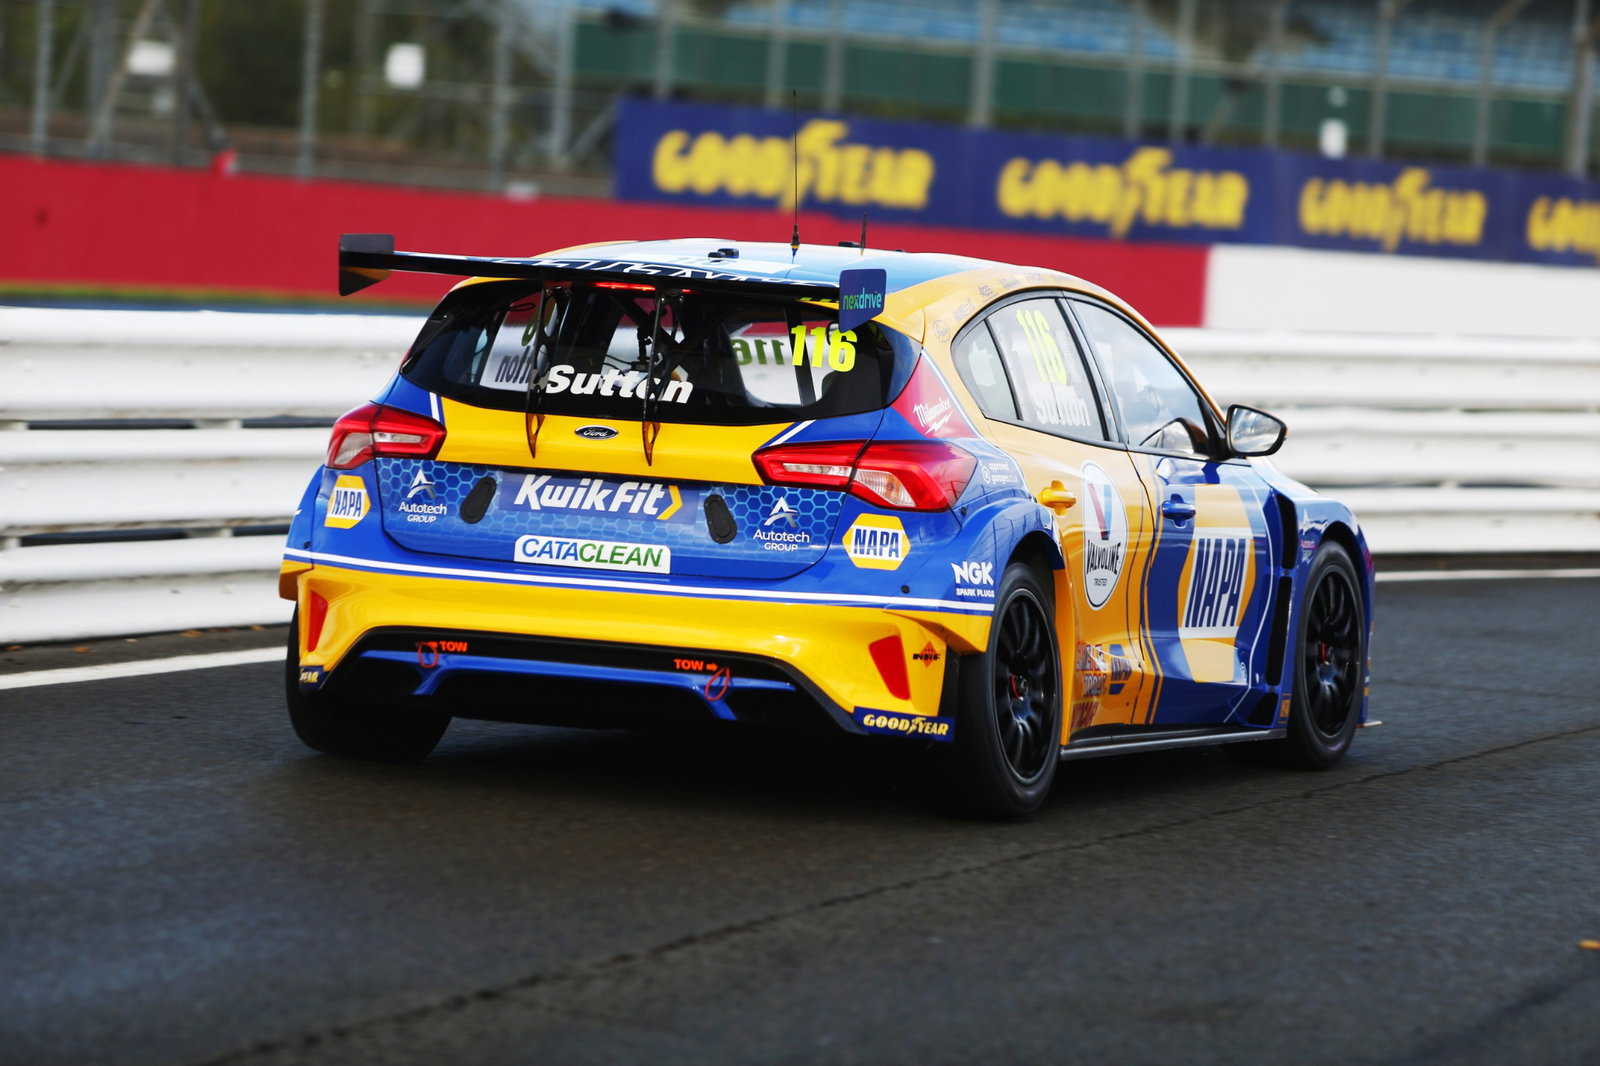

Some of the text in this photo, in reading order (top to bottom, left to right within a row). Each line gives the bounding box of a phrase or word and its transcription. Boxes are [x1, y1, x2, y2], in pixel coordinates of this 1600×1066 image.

[653, 118, 935, 213] GOODYEAR
[998, 146, 1248, 239] GOODYEAR
[1299, 166, 1488, 253] GOODYEAR
[843, 287, 882, 310] nexdrive
[791, 325, 858, 372] 116
[1016, 309, 1067, 385] 116
[546, 364, 693, 404] Sutton
[583, 427, 609, 437] Ford
[331, 488, 362, 518] NAPA
[399, 501, 447, 515] Autotech
[407, 515, 436, 523] GROUP
[753, 529, 809, 543] Autotech
[764, 542, 798, 552] GROUP
[853, 528, 899, 558] NAPA
[521, 538, 663, 568] CATACLEAN
[1086, 539, 1121, 575] VALVOLINE
[951, 561, 994, 586] NGK
[1184, 538, 1247, 628] NAPA
[956, 588, 995, 598] SPARK PLUGS
[440, 641, 468, 652] TOW
[673, 658, 704, 671] TOW
[862, 713, 949, 737] GOODYEAR
